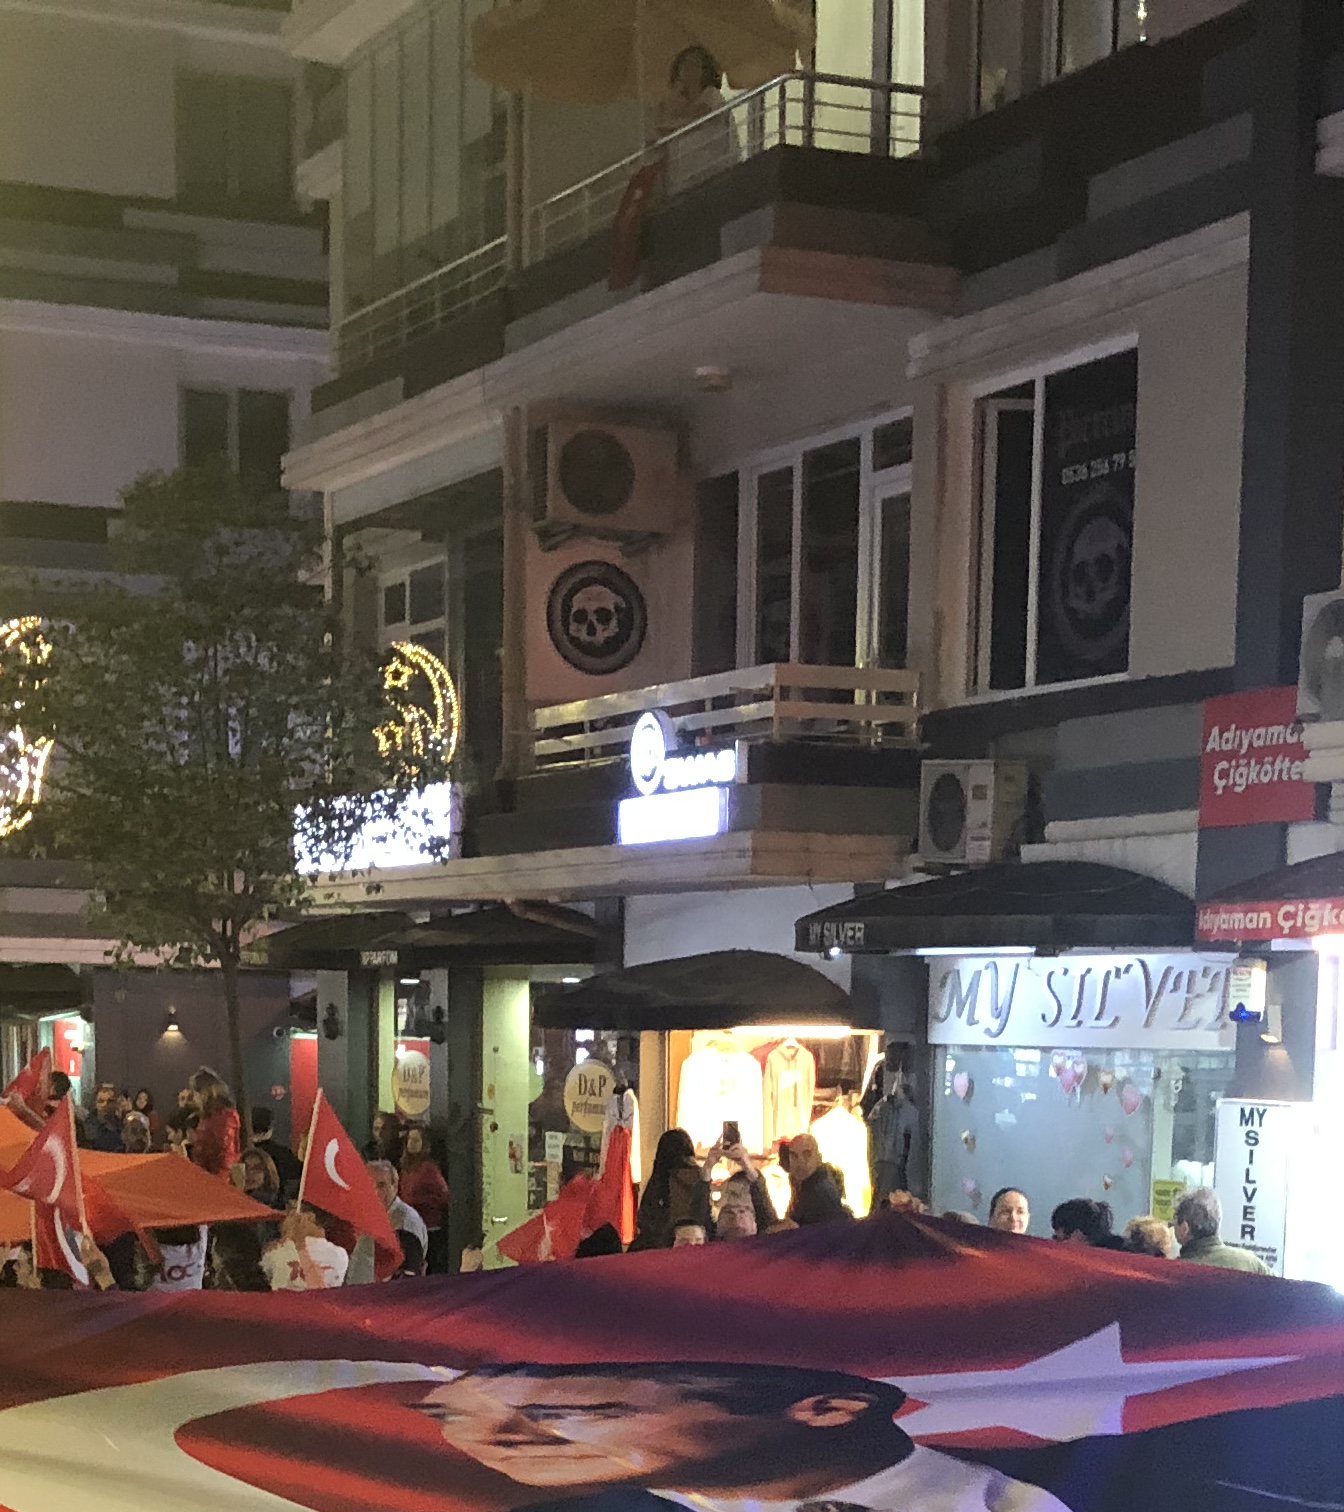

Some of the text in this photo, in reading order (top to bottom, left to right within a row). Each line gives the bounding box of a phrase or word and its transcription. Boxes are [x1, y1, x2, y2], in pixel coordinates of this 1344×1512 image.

[1213, 754, 1305, 795] Çiğköfte
[823, 920, 865, 947] SILVER
[933, 960, 1021, 1039] MY
[577, 1072, 608, 1098] D&P
[1239, 1106, 1268, 1128] MY
[1240, 1129, 1260, 1241] SILVER
